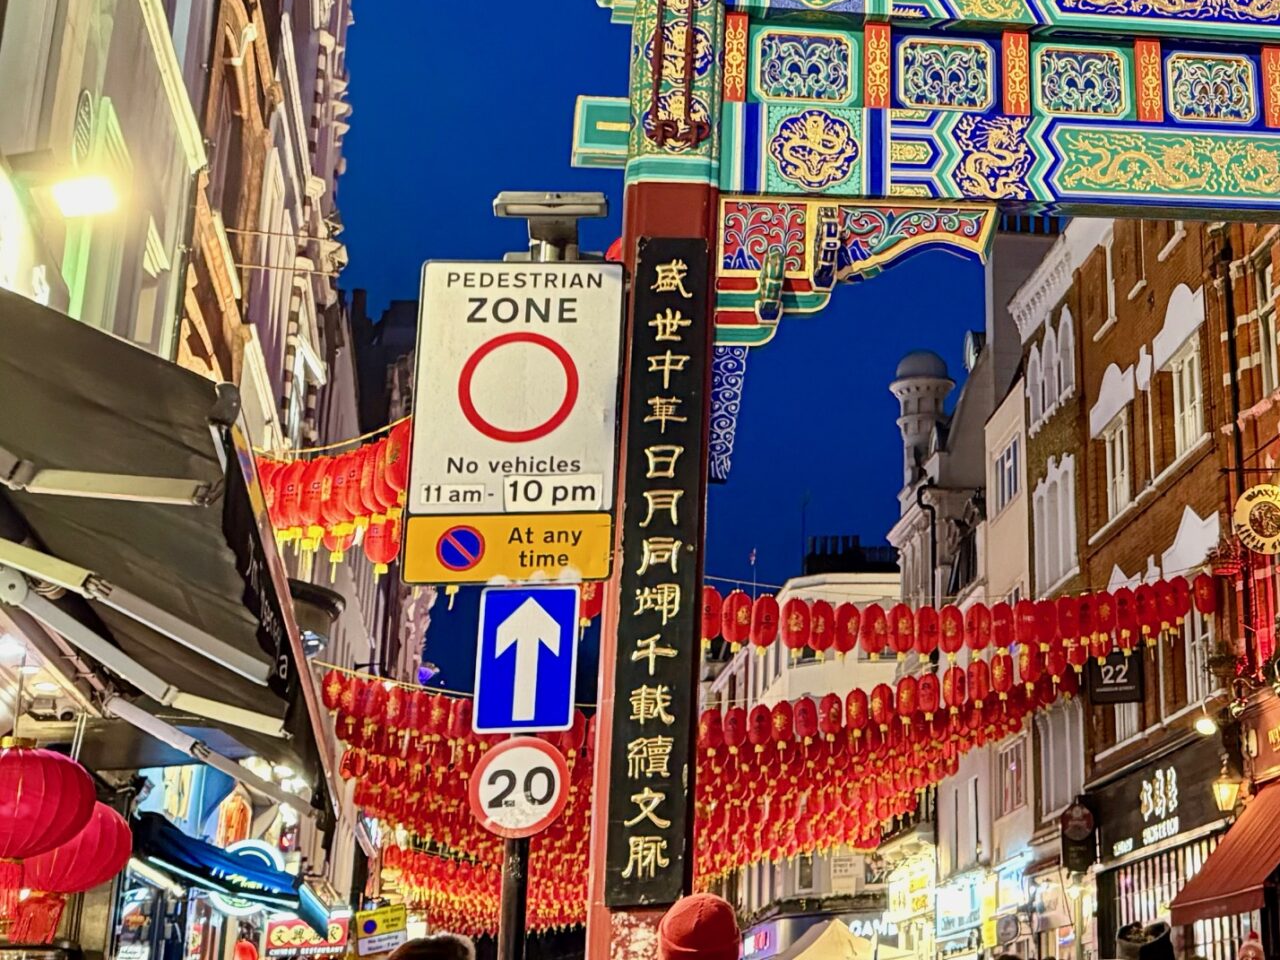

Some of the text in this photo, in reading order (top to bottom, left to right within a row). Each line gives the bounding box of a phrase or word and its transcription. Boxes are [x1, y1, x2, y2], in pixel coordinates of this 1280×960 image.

[447, 272, 603, 288] PEDESTRIAN
[466, 297, 578, 323] ZONE
[447, 456, 581, 474] No vehicles
[508, 480, 543, 503] 10
[552, 484, 596, 506] pm
[508, 527, 582, 547] At any
[519, 550, 569, 567] time
[1102, 664, 1128, 684] 22
[488, 766, 555, 808] 20
